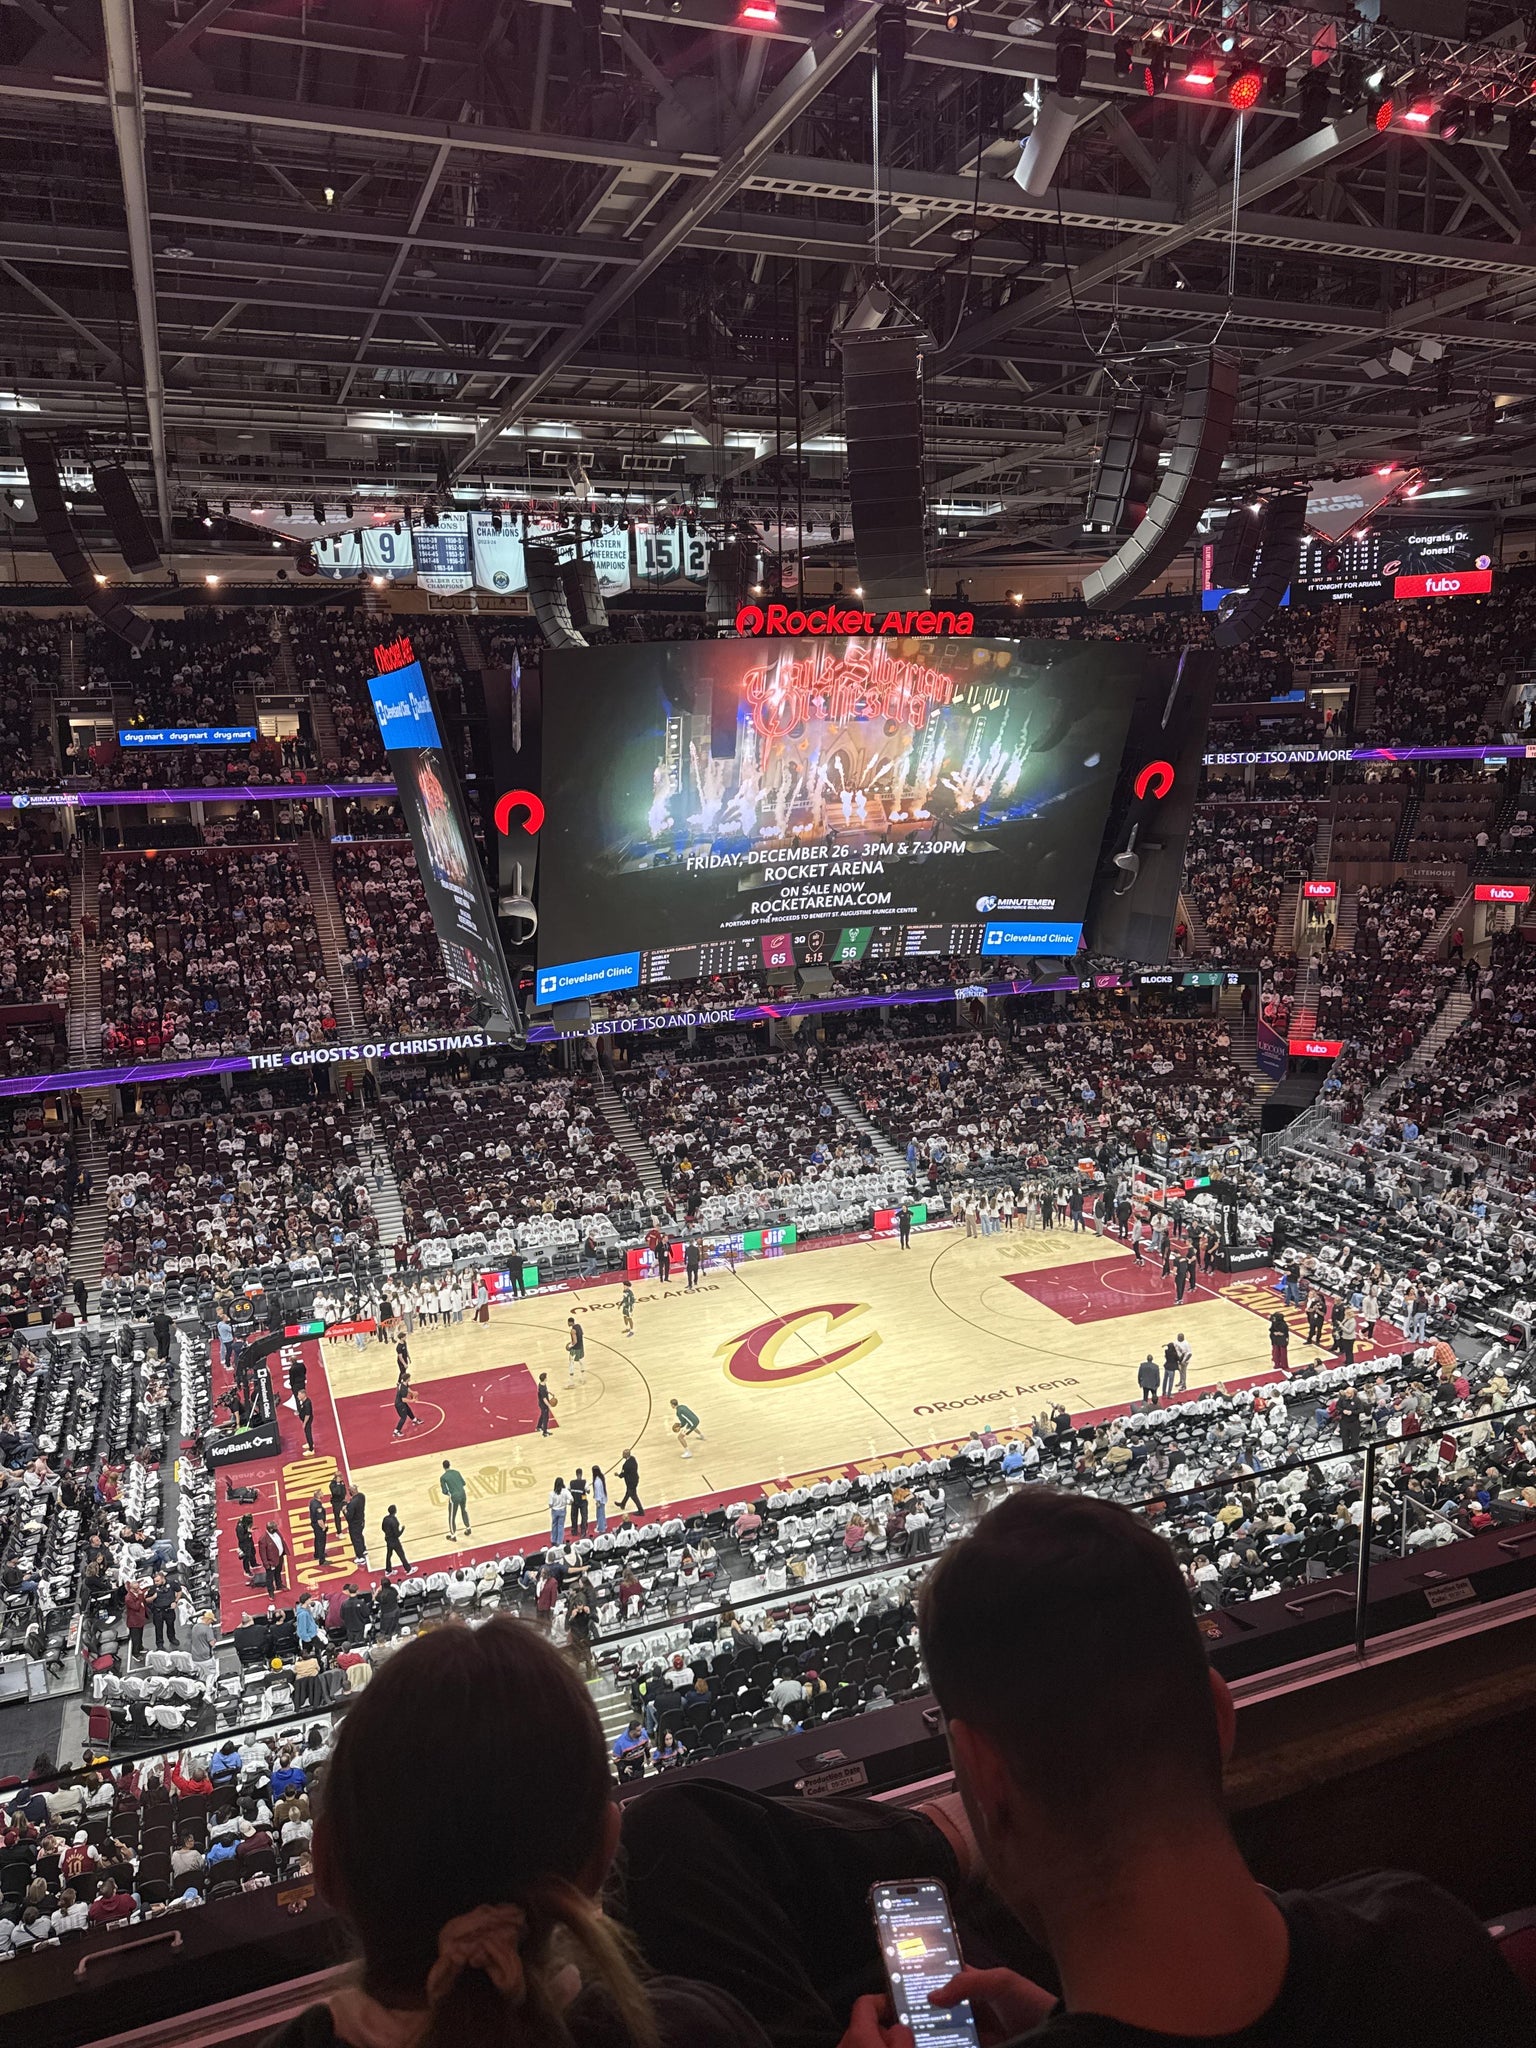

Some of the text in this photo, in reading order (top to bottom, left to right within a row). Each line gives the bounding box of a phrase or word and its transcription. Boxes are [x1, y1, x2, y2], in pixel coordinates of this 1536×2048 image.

[591, 539, 621, 549] WESTERN
[1408, 532, 1469, 546] Congrats, Dr.
[379, 532, 395, 564] 9
[644, 539, 673, 569] 15
[1420, 546, 1455, 556] Jones!!
[595, 561, 626, 570] AMPIONS
[1425, 577, 1461, 593] fubo
[767, 604, 974, 635] Rocket Arena
[125, 734, 143, 742] drug
[169, 733, 188, 741] drug
[214, 731, 232, 740] drug
[1216, 750, 1353, 764] BEST OF TSO AND MORE
[686, 841, 966, 871] FRIDAY, DECEMBER 26 3PM & 7:30PM
[764, 860, 884, 882] ROCKET ARENA
[780, 881, 865, 898] ON SALE NOW
[1309, 884, 1332, 894] fubo
[1490, 888, 1514, 898] fubo
[750, 892, 892, 915] ROCKETARENA.COM
[725, 920, 750, 928] PORTION
[772, 914, 800, 923] PROCEEDS
[809, 911, 831, 919] BENEFIT
[840, 909, 871, 917] AUGUSTINE
[794, 936, 806, 944] 3Q
[1003, 933, 1074, 943] Cleveland Clinic
[770, 953, 786, 964] 65
[805, 953, 823, 963] 5:15
[841, 947, 857, 958] 56
[558, 966, 633, 988] Cleveland Clinic
[1141, 975, 1199, 984] BLOCKS 2
[588, 1021, 618, 1035] BEST
[621, 1019, 638, 1032] OF
[640, 1016, 666, 1030] TSO
[668, 1014, 696, 1027] AND
[700, 1009, 736, 1023] MORE
[249, 1053, 283, 1069] THE
[290, 1046, 359, 1065] GHOSTS
[363, 1044, 386, 1058] OF
[389, 1033, 488, 1056] CHRISTMAS
[1259, 1042, 1285, 1056] LECOM
[1305, 1044, 1328, 1053] fubo
[764, 1229, 786, 1245] Jif
[996, 1239, 1071, 1258] CAVS
[1230, 1252, 1256, 1262] KeyBank
[663, 1284, 720, 1300] Arena
[933, 1376, 1080, 1413] Rocket Arena
[211, 1441, 253, 1458] KeyBank
[804, 1772, 843, 1787] Production
[68, 1860, 82, 1877] 10
